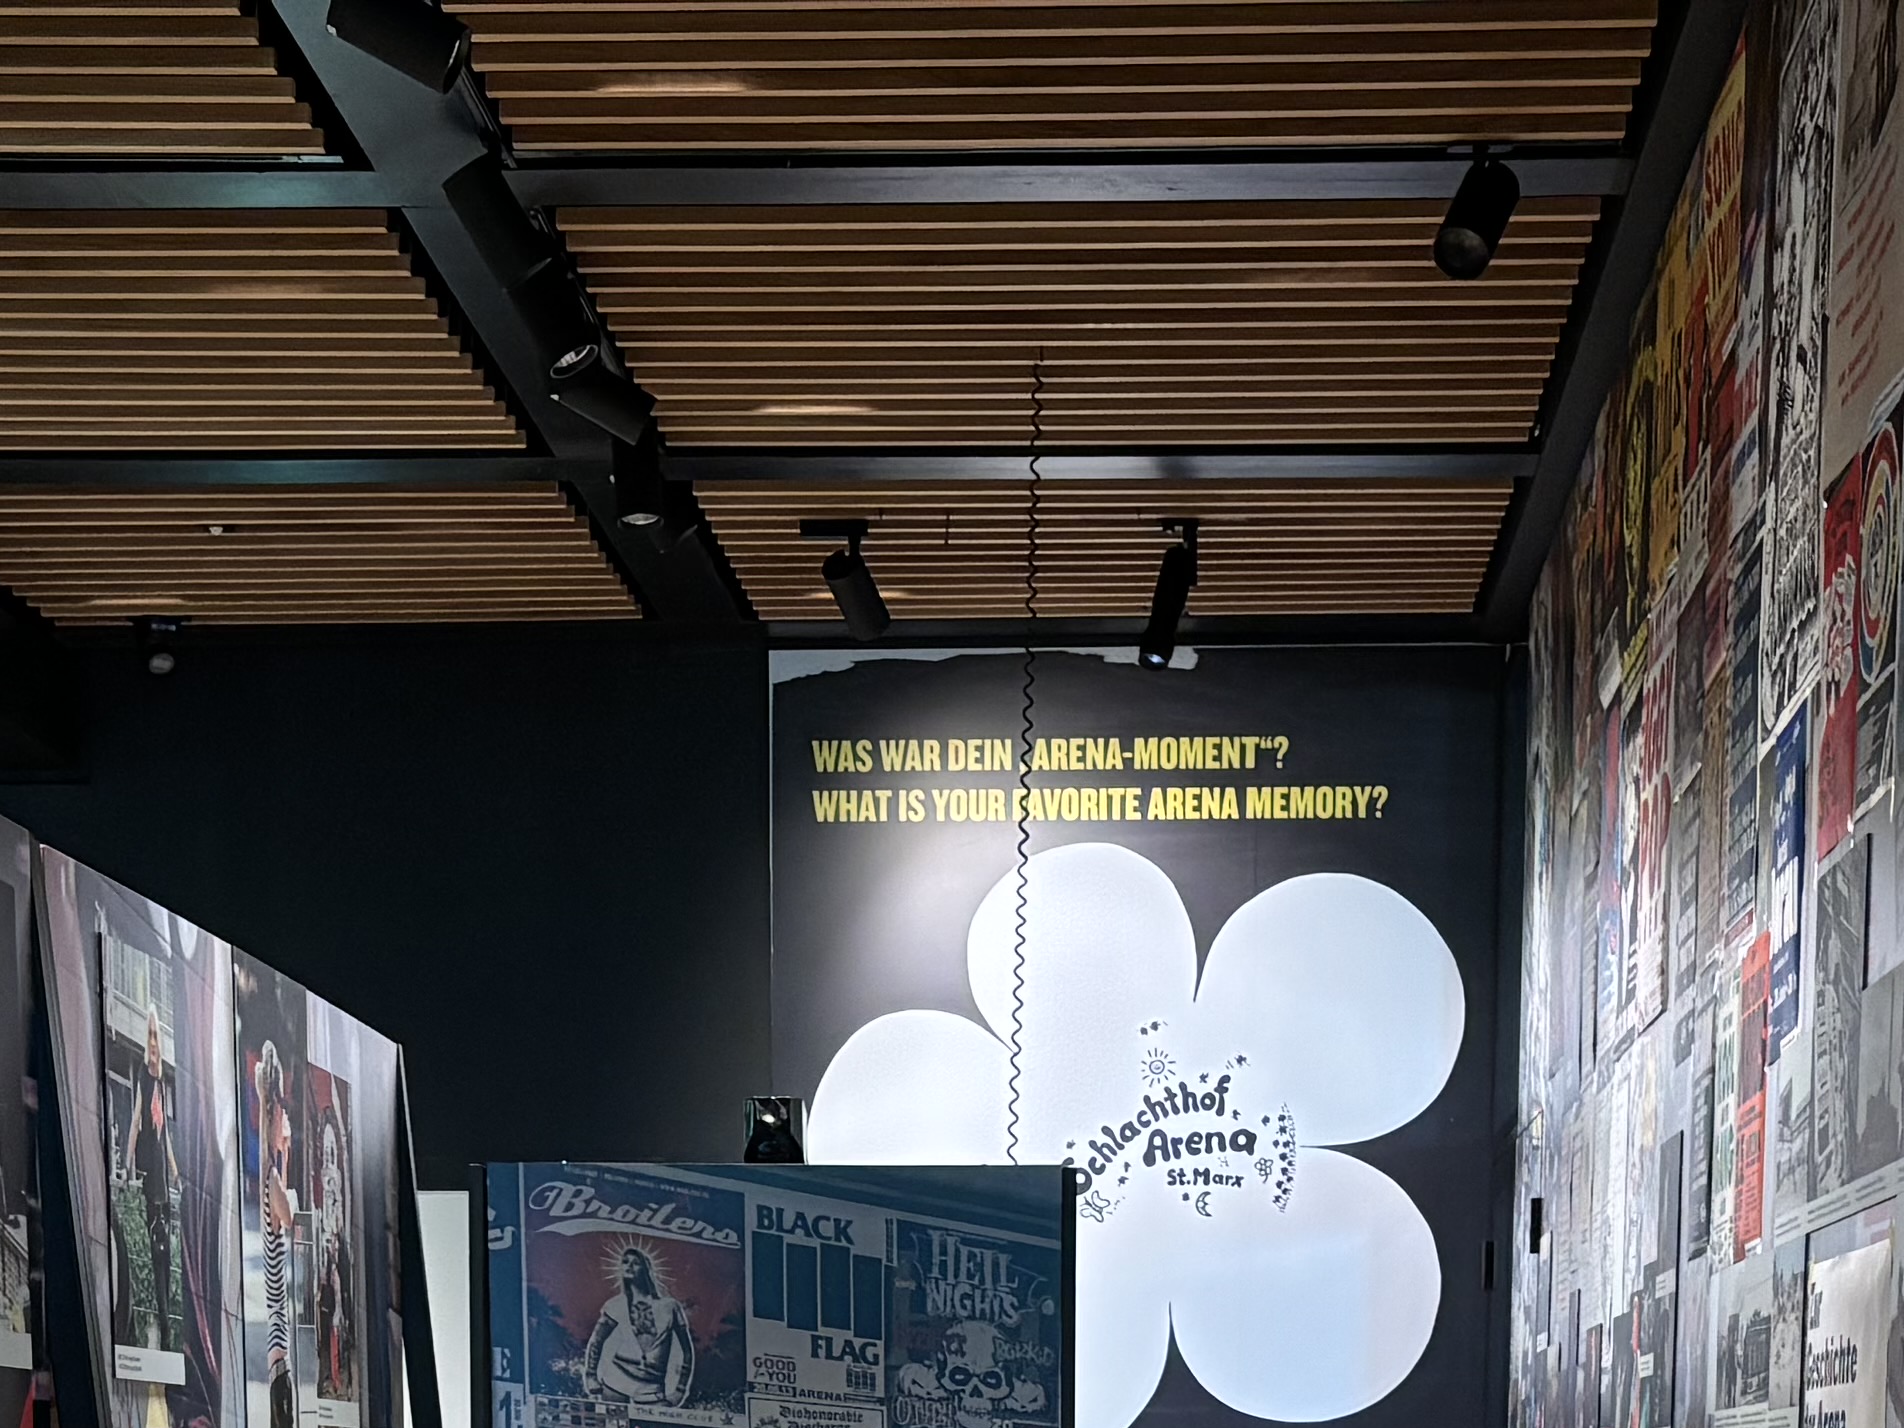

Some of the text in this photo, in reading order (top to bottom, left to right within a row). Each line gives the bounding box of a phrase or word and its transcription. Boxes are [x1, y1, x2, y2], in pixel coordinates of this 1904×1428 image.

[812, 739, 872, 773] WAS
[879, 739, 941, 773] WAR
[947, 738, 1012, 772] DEIN
[812, 785, 1389, 823] WHAT IS YOUR FAVORITE ARENA MEMORY?
[1143, 1128, 1257, 1168] Arena
[529, 1180, 739, 1245] Broilers
[755, 1204, 854, 1246] BLACK
[927, 1229, 1019, 1289] HELL
[925, 1278, 1021, 1328] NIGHTS
[752, 1357, 796, 1372] GOOD
[811, 1335, 880, 1367] FLAG
[798, 1389, 844, 1402] ARENA
